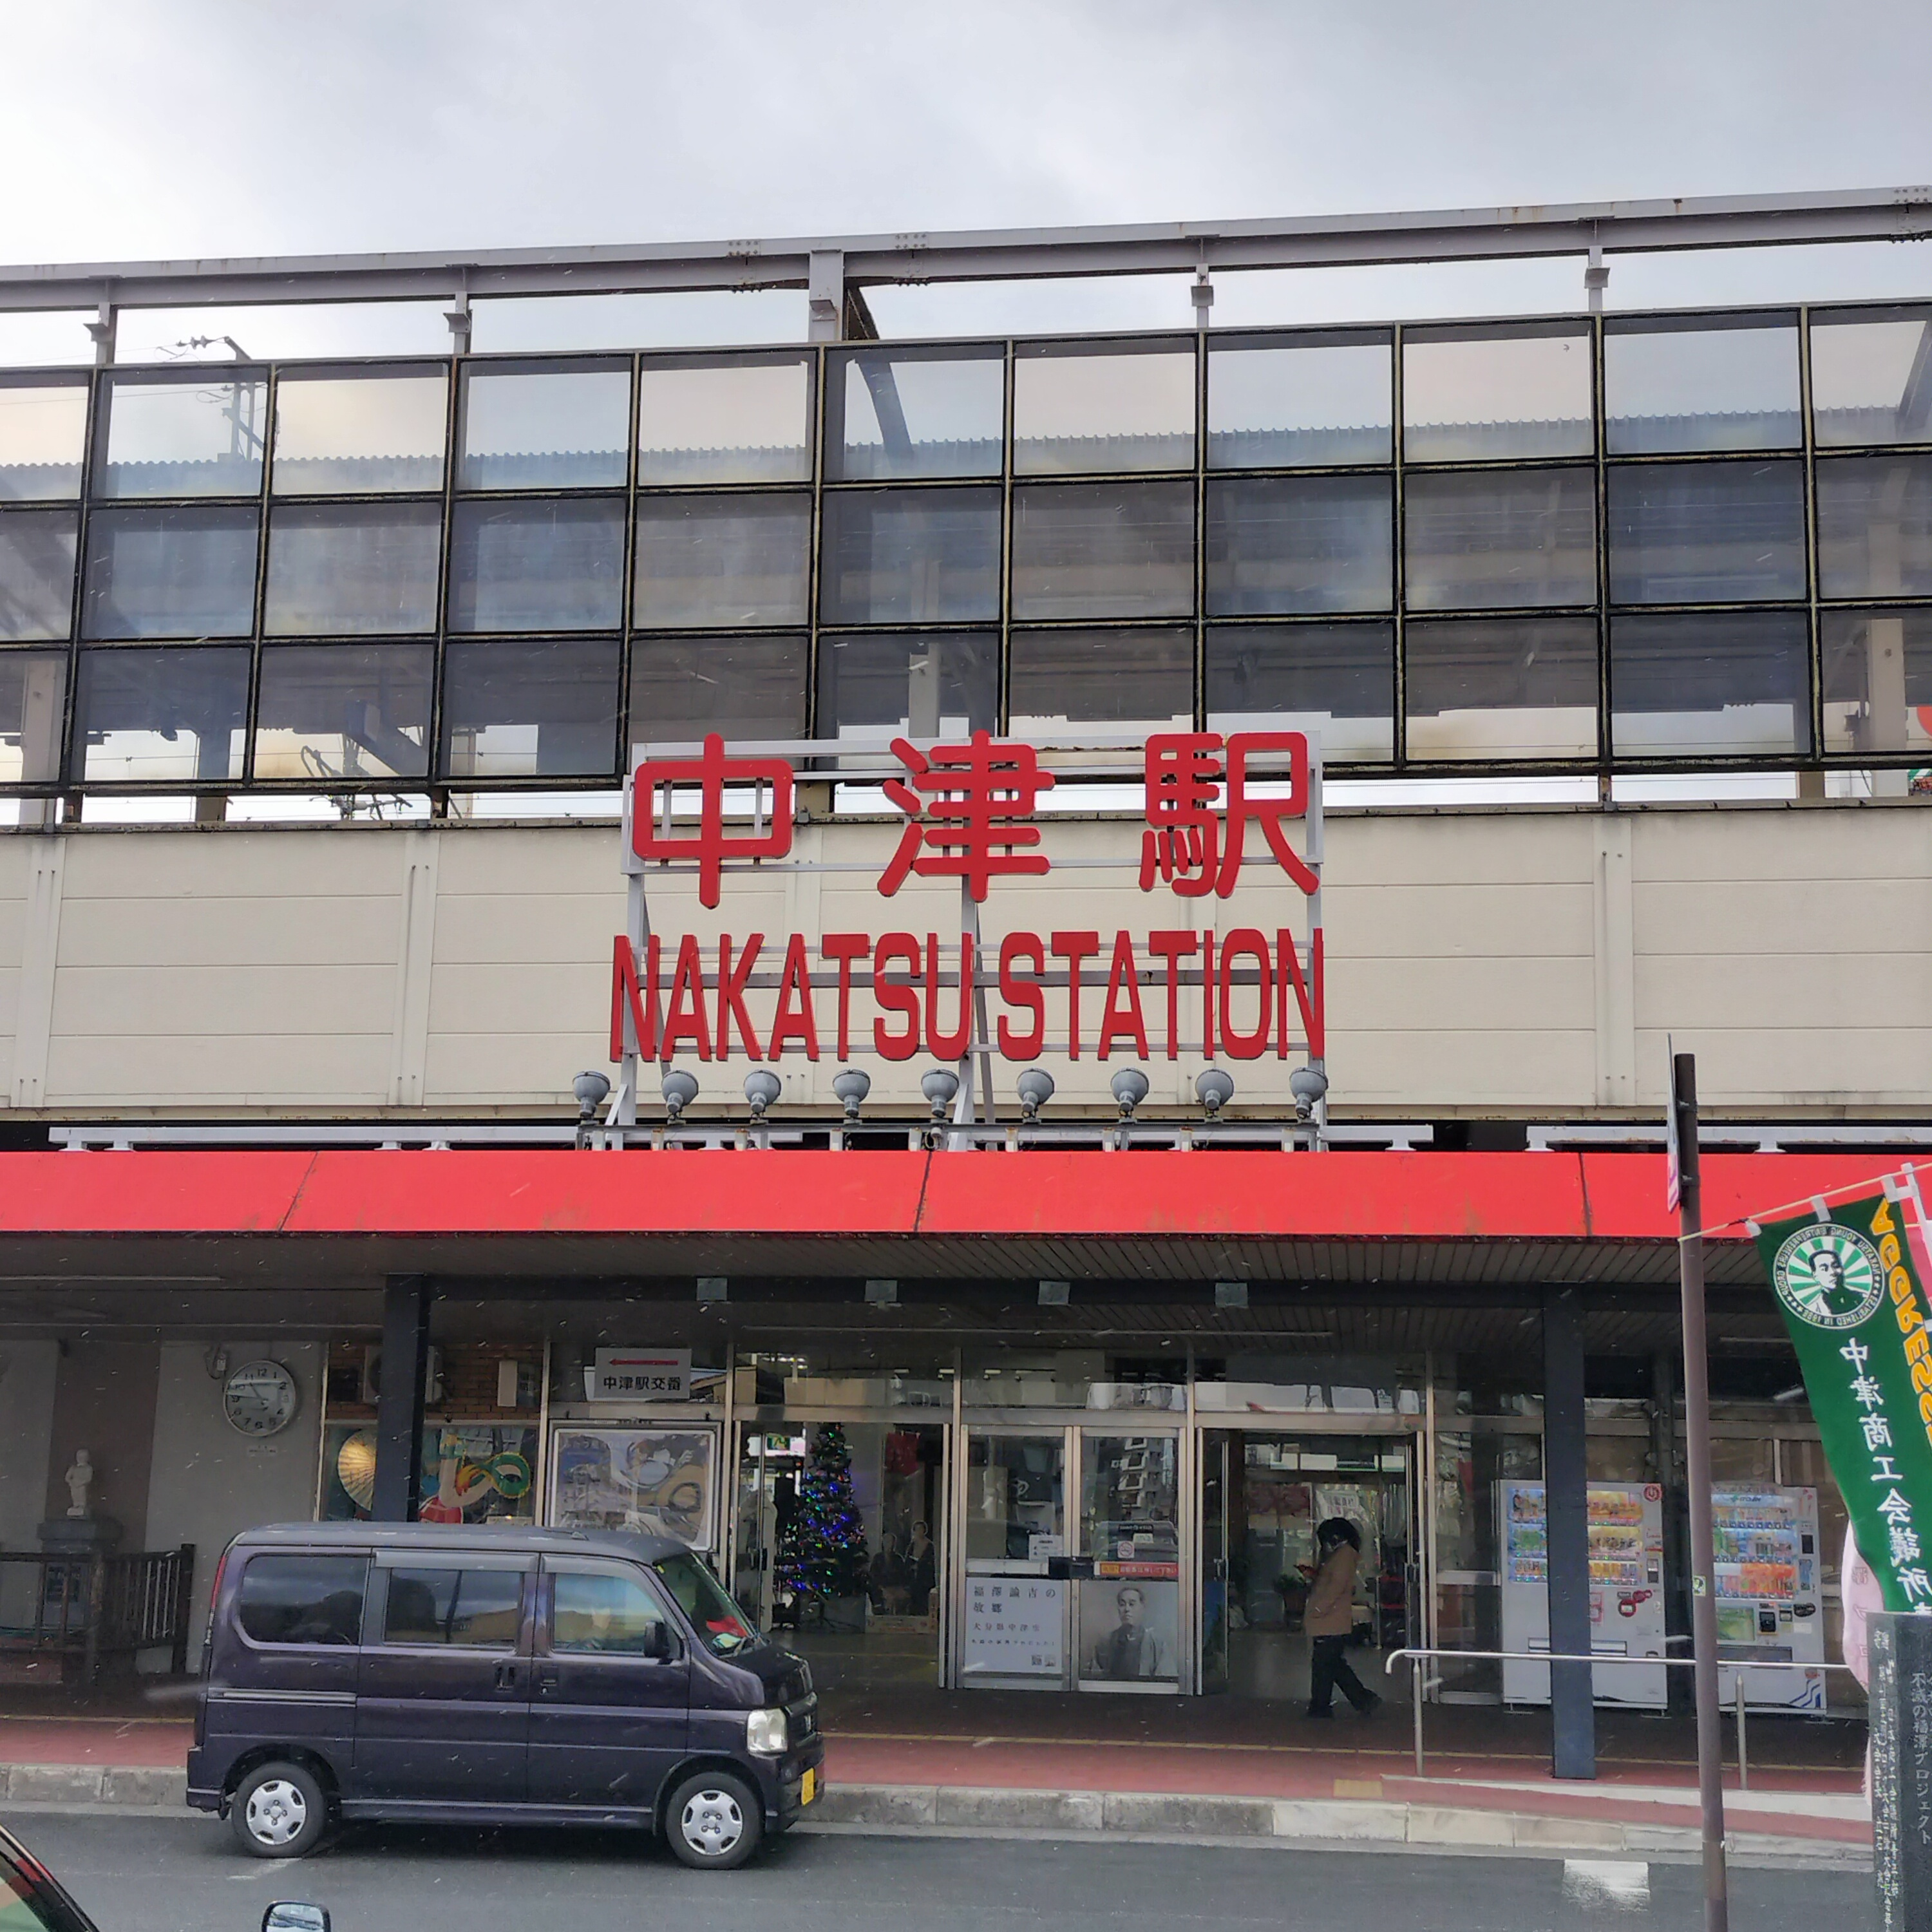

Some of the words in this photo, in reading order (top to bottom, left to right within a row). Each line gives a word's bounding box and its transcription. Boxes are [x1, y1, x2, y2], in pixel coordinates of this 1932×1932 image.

[632, 730, 1320, 909] 中津駅
[609, 932, 974, 1063] NAKATSU
[997, 927, 1325, 1061] STATION
[603, 1376, 682, 1391] 中津駅交番
